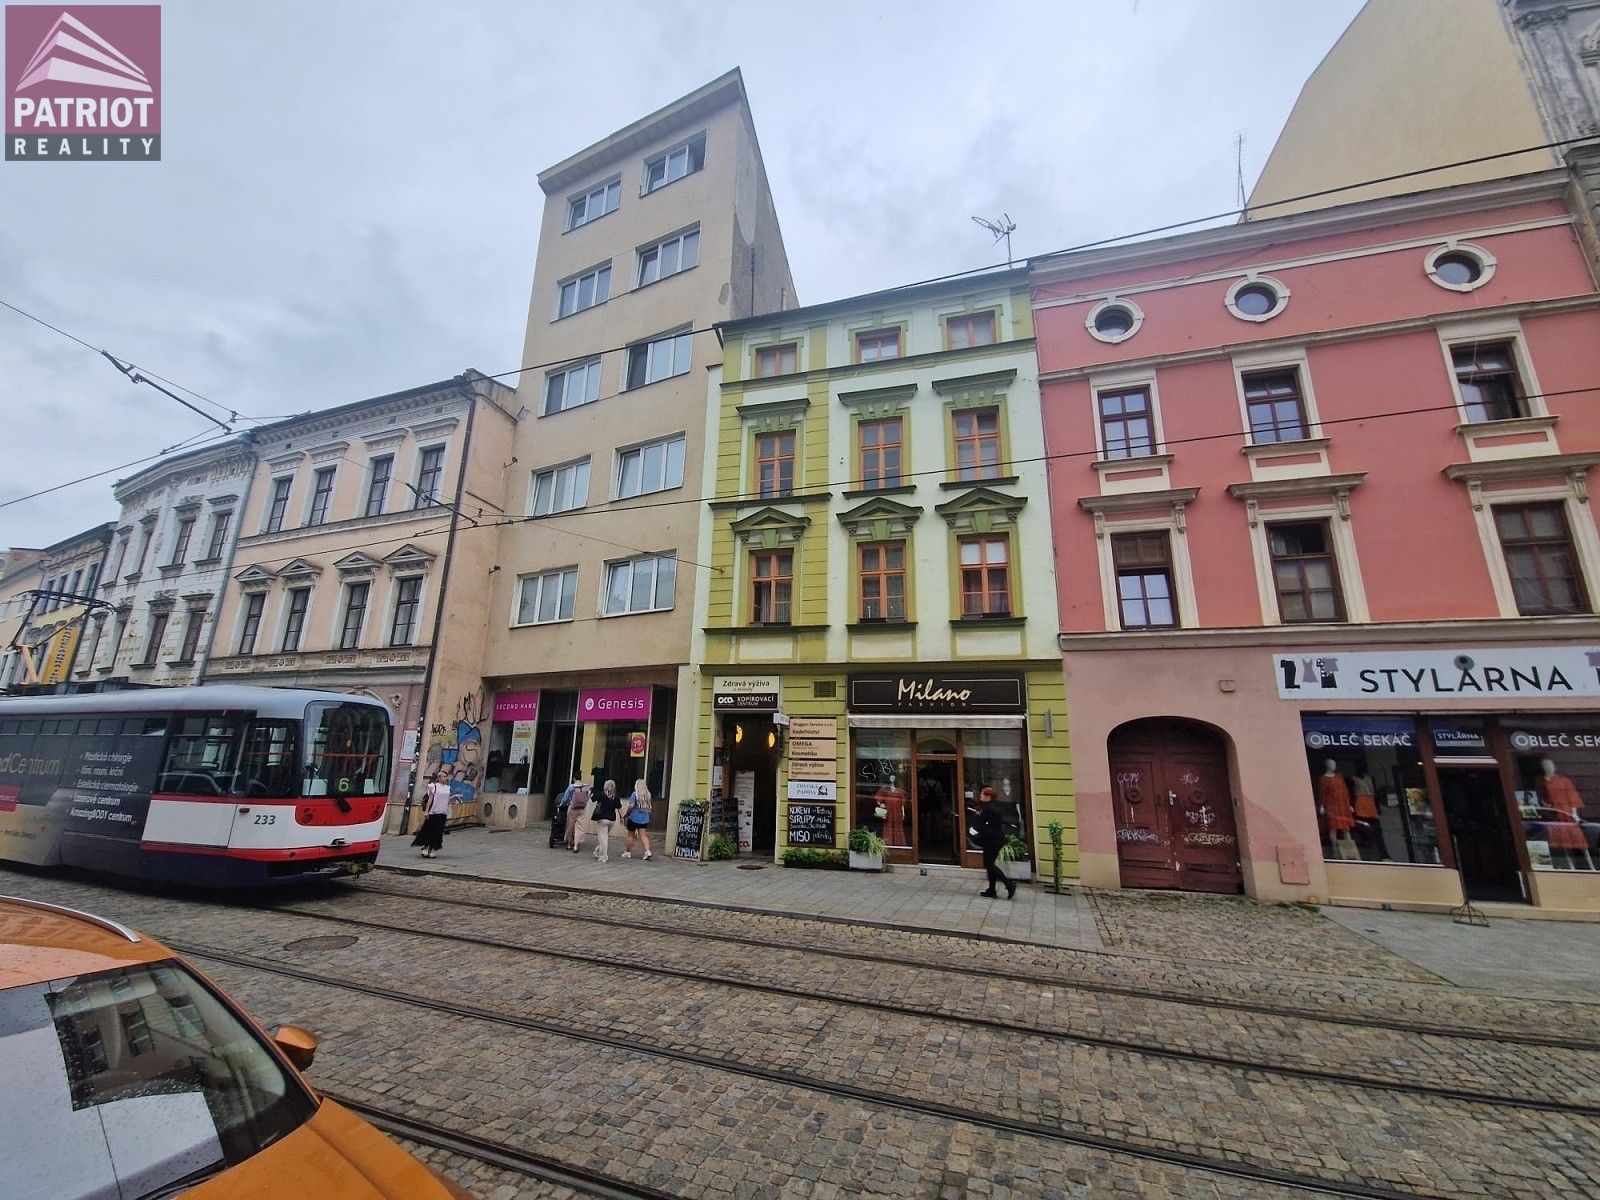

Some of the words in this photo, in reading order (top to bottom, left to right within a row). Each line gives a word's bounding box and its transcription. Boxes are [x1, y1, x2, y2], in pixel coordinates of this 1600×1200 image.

[897, 677, 973, 701] Milano
[598, 697, 645, 710] Genesis
[737, 694, 774, 702] KOPÍROVACÍ
[520, 702, 537, 710] HAND
[1309, 732, 1360, 746] OBLEČ
[1363, 732, 1412, 746] SEKÁČ
[1515, 732, 1570, 747] OBLEČ
[338, 777, 350, 792] 6
[253, 814, 276, 826] 233
[789, 830, 811, 842] MISO
